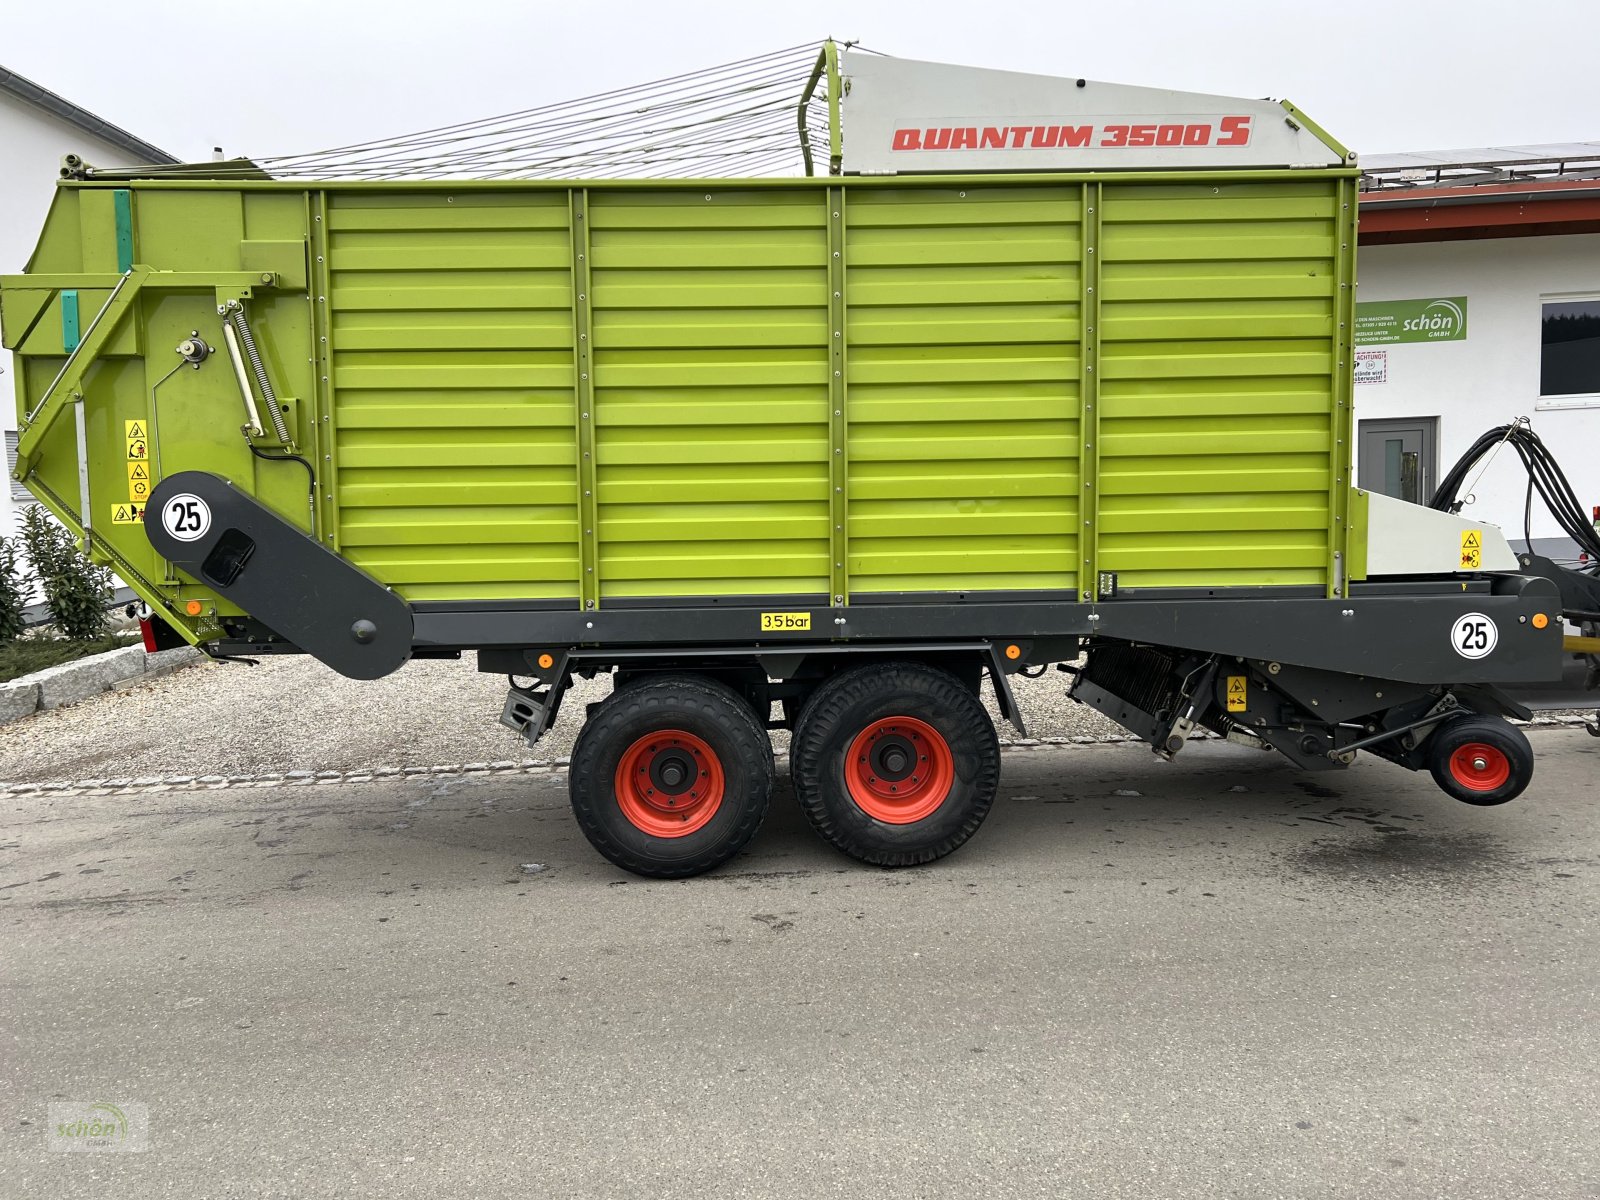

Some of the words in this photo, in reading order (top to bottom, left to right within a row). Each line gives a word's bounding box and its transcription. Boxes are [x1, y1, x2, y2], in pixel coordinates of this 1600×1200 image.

[892, 125, 1093, 151] QUANTUM
[1100, 124, 1212, 148] 3500
[1215, 116, 1251, 146] S
[1402, 313, 1453, 331] schön
[1356, 353, 1384, 361] ACHTUNG!
[172, 502, 202, 532] 25
[1462, 622, 1488, 650] 25
